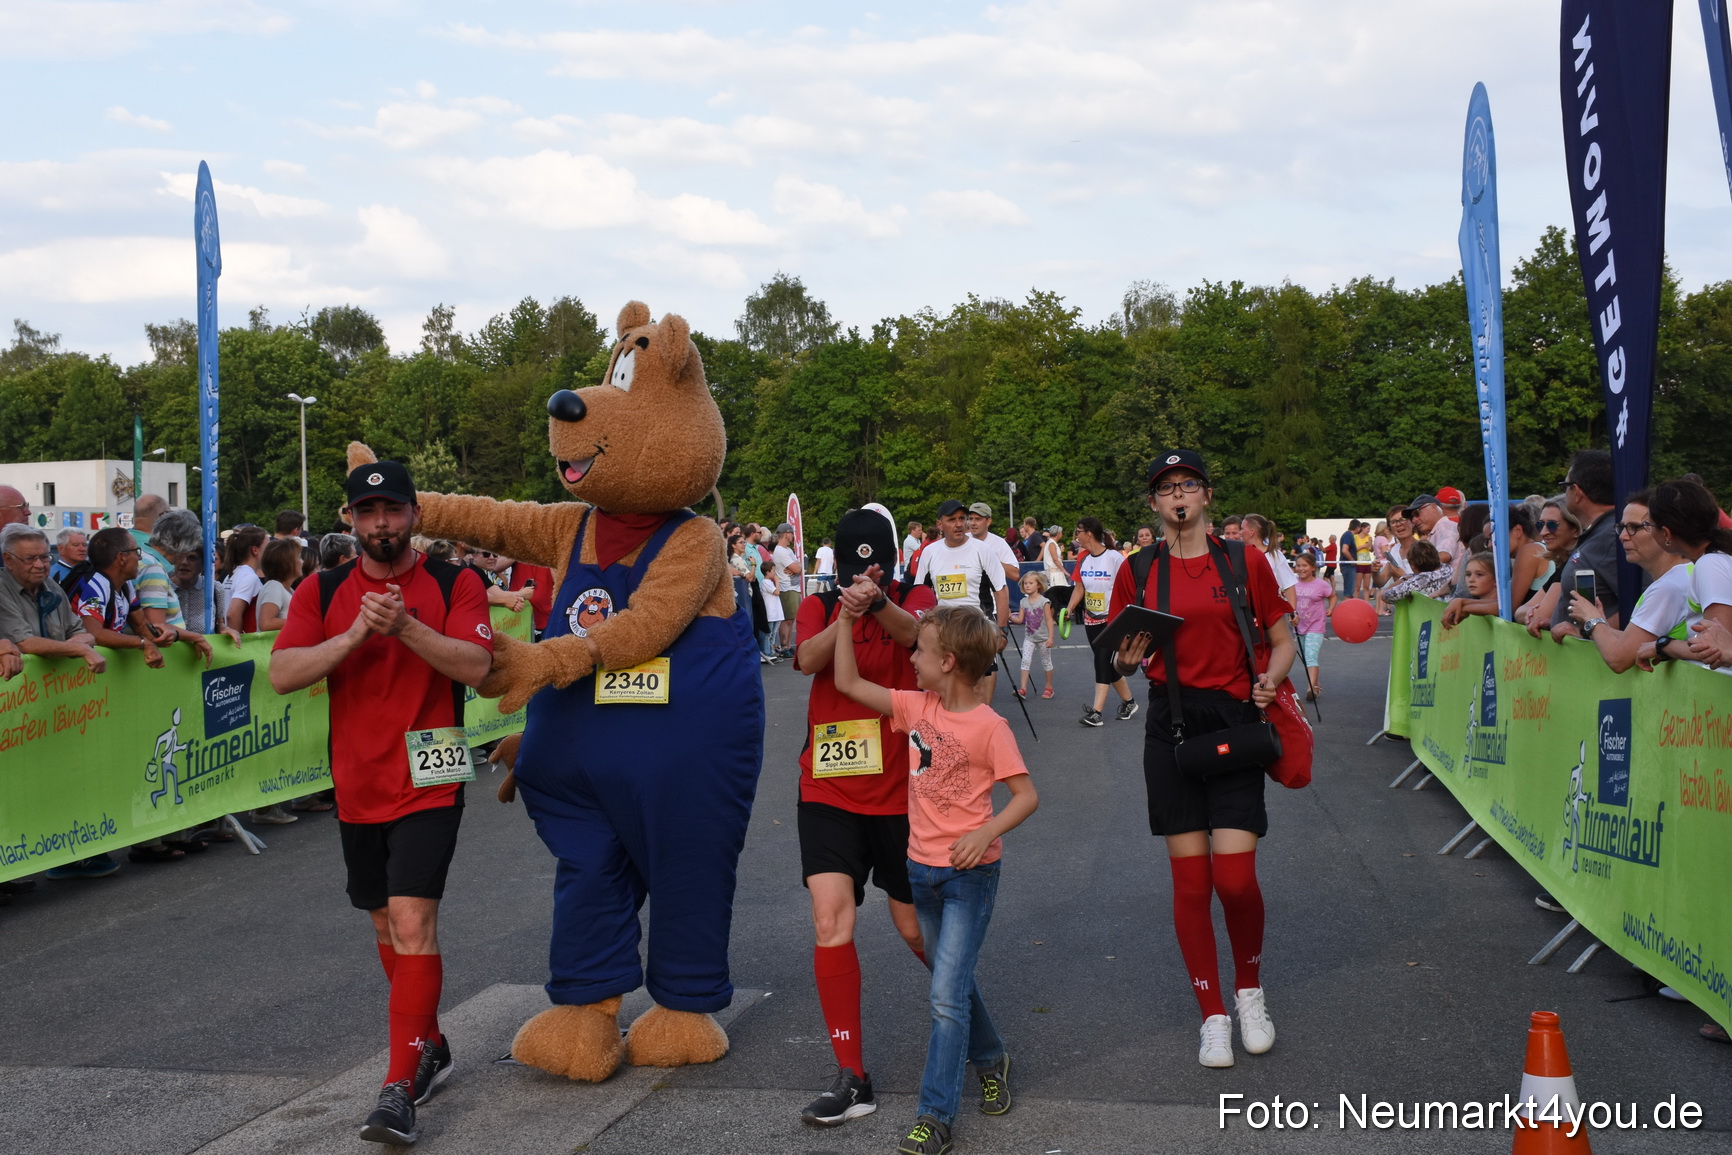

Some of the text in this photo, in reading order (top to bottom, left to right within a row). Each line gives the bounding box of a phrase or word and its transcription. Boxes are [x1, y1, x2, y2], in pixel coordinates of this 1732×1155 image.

[939, 582, 962, 592] 2377
[604, 672, 659, 690] 2340
[212, 684, 244, 702] Fischer
[53, 685, 109, 735] länger!
[186, 703, 291, 780] firmenlauf
[820, 739, 868, 762] 2361
[1604, 731, 1626, 750] Fischer
[417, 747, 467, 771] 2332
[188, 765, 235, 796] neumarkt
[1585, 792, 1664, 866] firmenlauf
[1580, 857, 1611, 879] neumarkt
